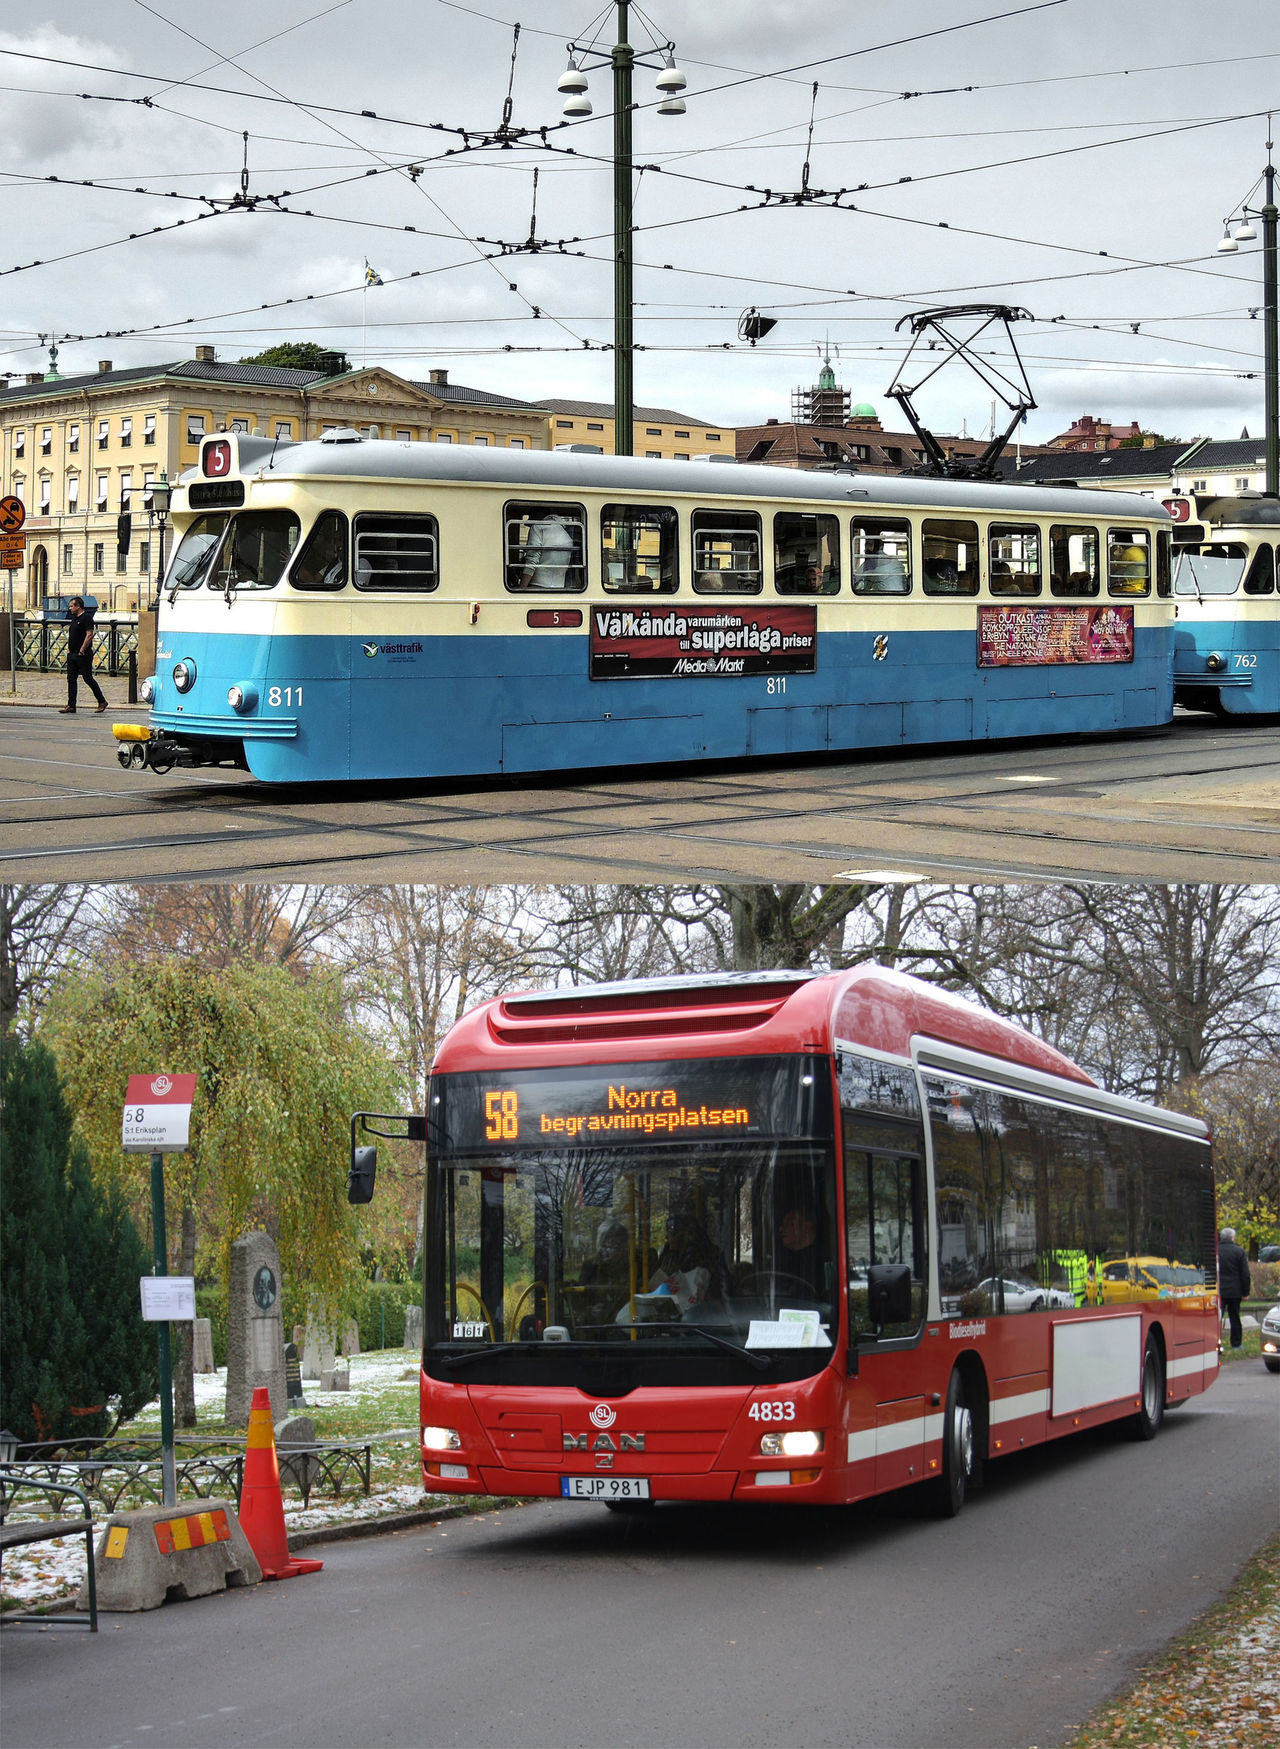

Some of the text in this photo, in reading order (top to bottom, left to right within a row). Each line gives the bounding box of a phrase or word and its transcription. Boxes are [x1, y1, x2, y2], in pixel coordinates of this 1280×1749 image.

[214, 442, 225, 471] 5
[1170, 501, 1181, 520] 5
[553, 611, 560, 624] 5
[596, 611, 742, 637] Välkända varumärken
[998, 613, 1034, 625] OUTKAST
[1013, 625, 1042, 634] QUEENS
[1043, 625, 1052, 633] OF
[680, 623, 813, 654] till superlåga priser
[380, 642, 424, 654] västtrafik
[672, 657, 745, 673] Media Markt
[1234, 654, 1257, 668] 762
[767, 677, 786, 694] 811
[268, 686, 303, 707] 811
[608, 1085, 677, 1110] Norra
[125, 1108, 145, 1122] 58
[485, 1091, 518, 1140] 58
[541, 1106, 749, 1136] begravningsplatsen
[135, 1126, 167, 1134] Eriksplan
[748, 1401, 796, 1421] 4833
[563, 1433, 645, 1451] MAN
[575, 1480, 641, 1496] EJP 981
